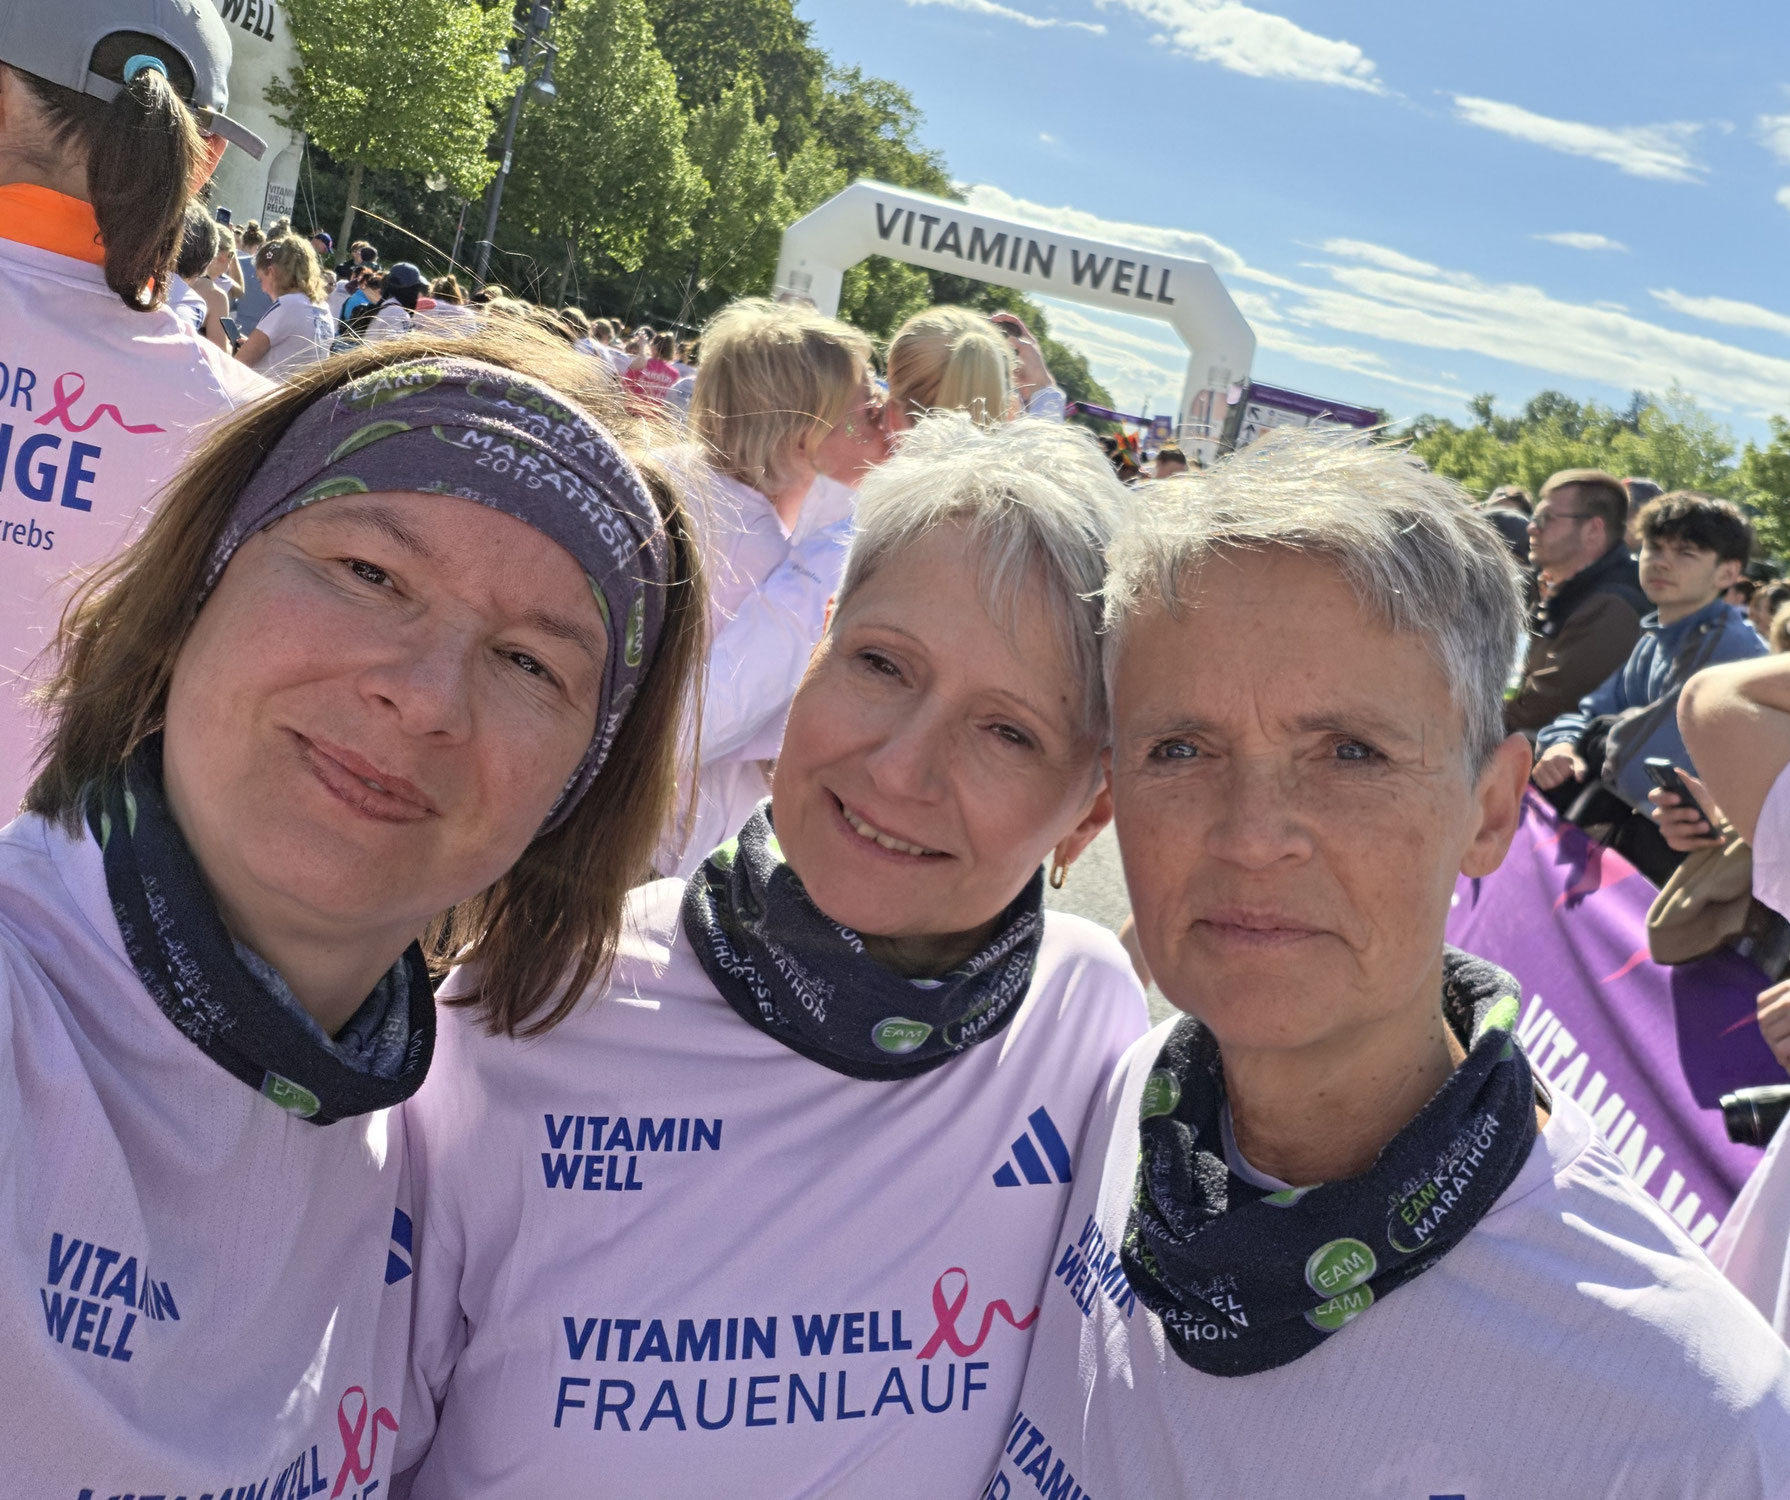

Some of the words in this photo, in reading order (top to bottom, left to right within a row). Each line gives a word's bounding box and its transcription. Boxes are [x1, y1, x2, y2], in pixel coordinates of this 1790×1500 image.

[220, 0, 275, 42] WELL
[876, 203, 1057, 280] VITAMIN
[1071, 249, 1175, 306] WELL
[475, 451, 543, 490] 2019
[462, 430, 627, 570] MARATHON
[0, 519, 55, 551] rebs
[881, 1026, 924, 1039] EAM
[544, 1114, 723, 1152] VITAMIN
[541, 1153, 643, 1192] WELL
[1413, 1113, 1500, 1241] MARATHON
[1055, 1244, 1099, 1317] WELL
[1318, 1251, 1366, 1288] EAM
[40, 1288, 138, 1362] WELL
[563, 1316, 778, 1363] VITAMIN
[792, 1310, 912, 1358] WELL
[553, 1362, 990, 1432] FRAUENLAUF
